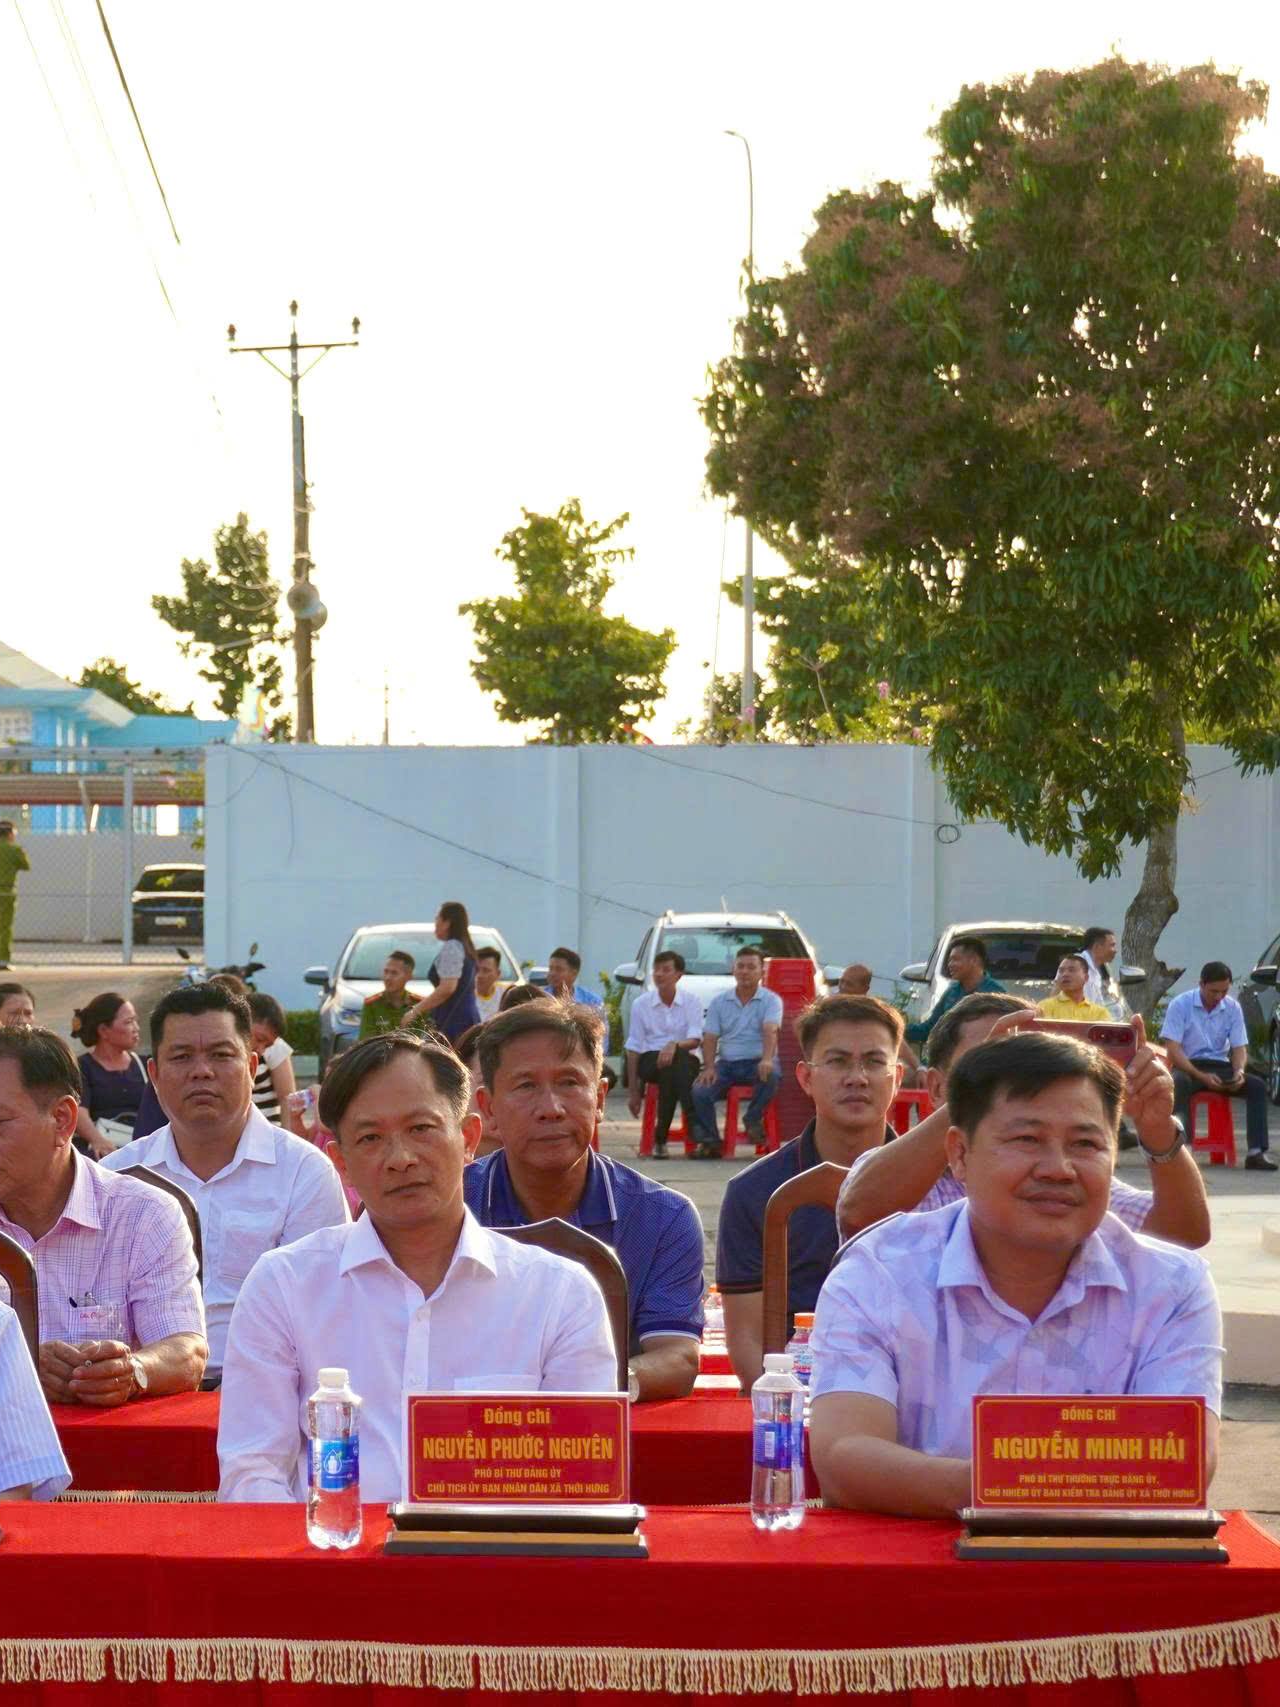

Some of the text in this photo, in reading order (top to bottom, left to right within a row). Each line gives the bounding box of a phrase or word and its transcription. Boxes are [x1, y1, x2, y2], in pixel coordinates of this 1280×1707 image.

[484, 1406, 550, 1425] Đồng chí
[1061, 1406, 1116, 1421] ĐỒNG CHÍ
[423, 1430, 612, 1459] NGUYỄN PHƯỚC NGUYÊN
[993, 1431, 1185, 1460] NGUYỄN MINH HẢI
